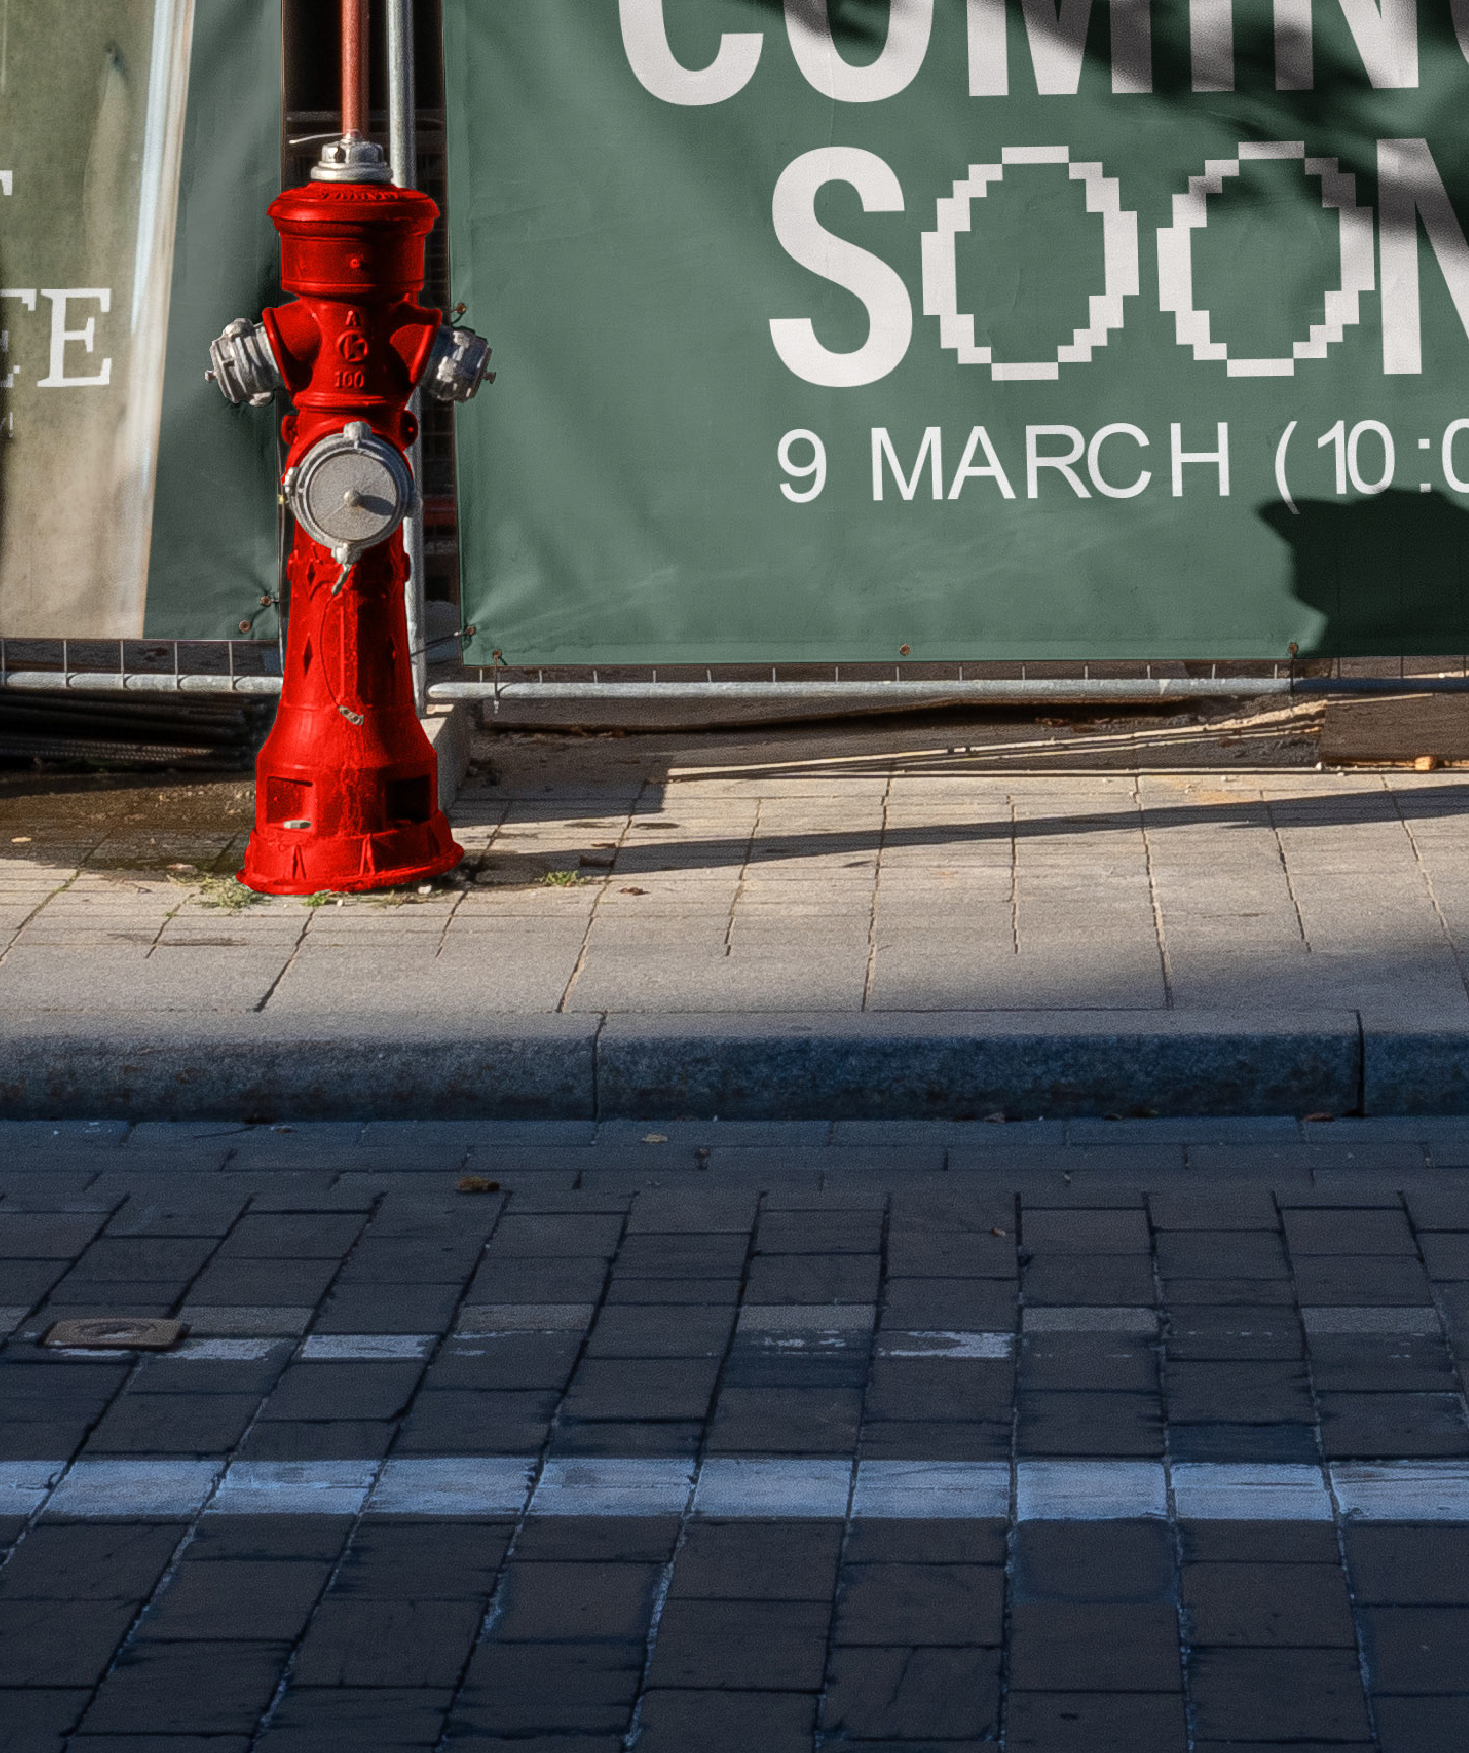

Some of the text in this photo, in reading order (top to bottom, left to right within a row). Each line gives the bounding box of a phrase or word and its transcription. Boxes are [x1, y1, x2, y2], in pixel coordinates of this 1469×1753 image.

[334, 370, 366, 389] 100
[776, 427, 828, 504] 9
[869, 421, 1230, 502] MARCH
